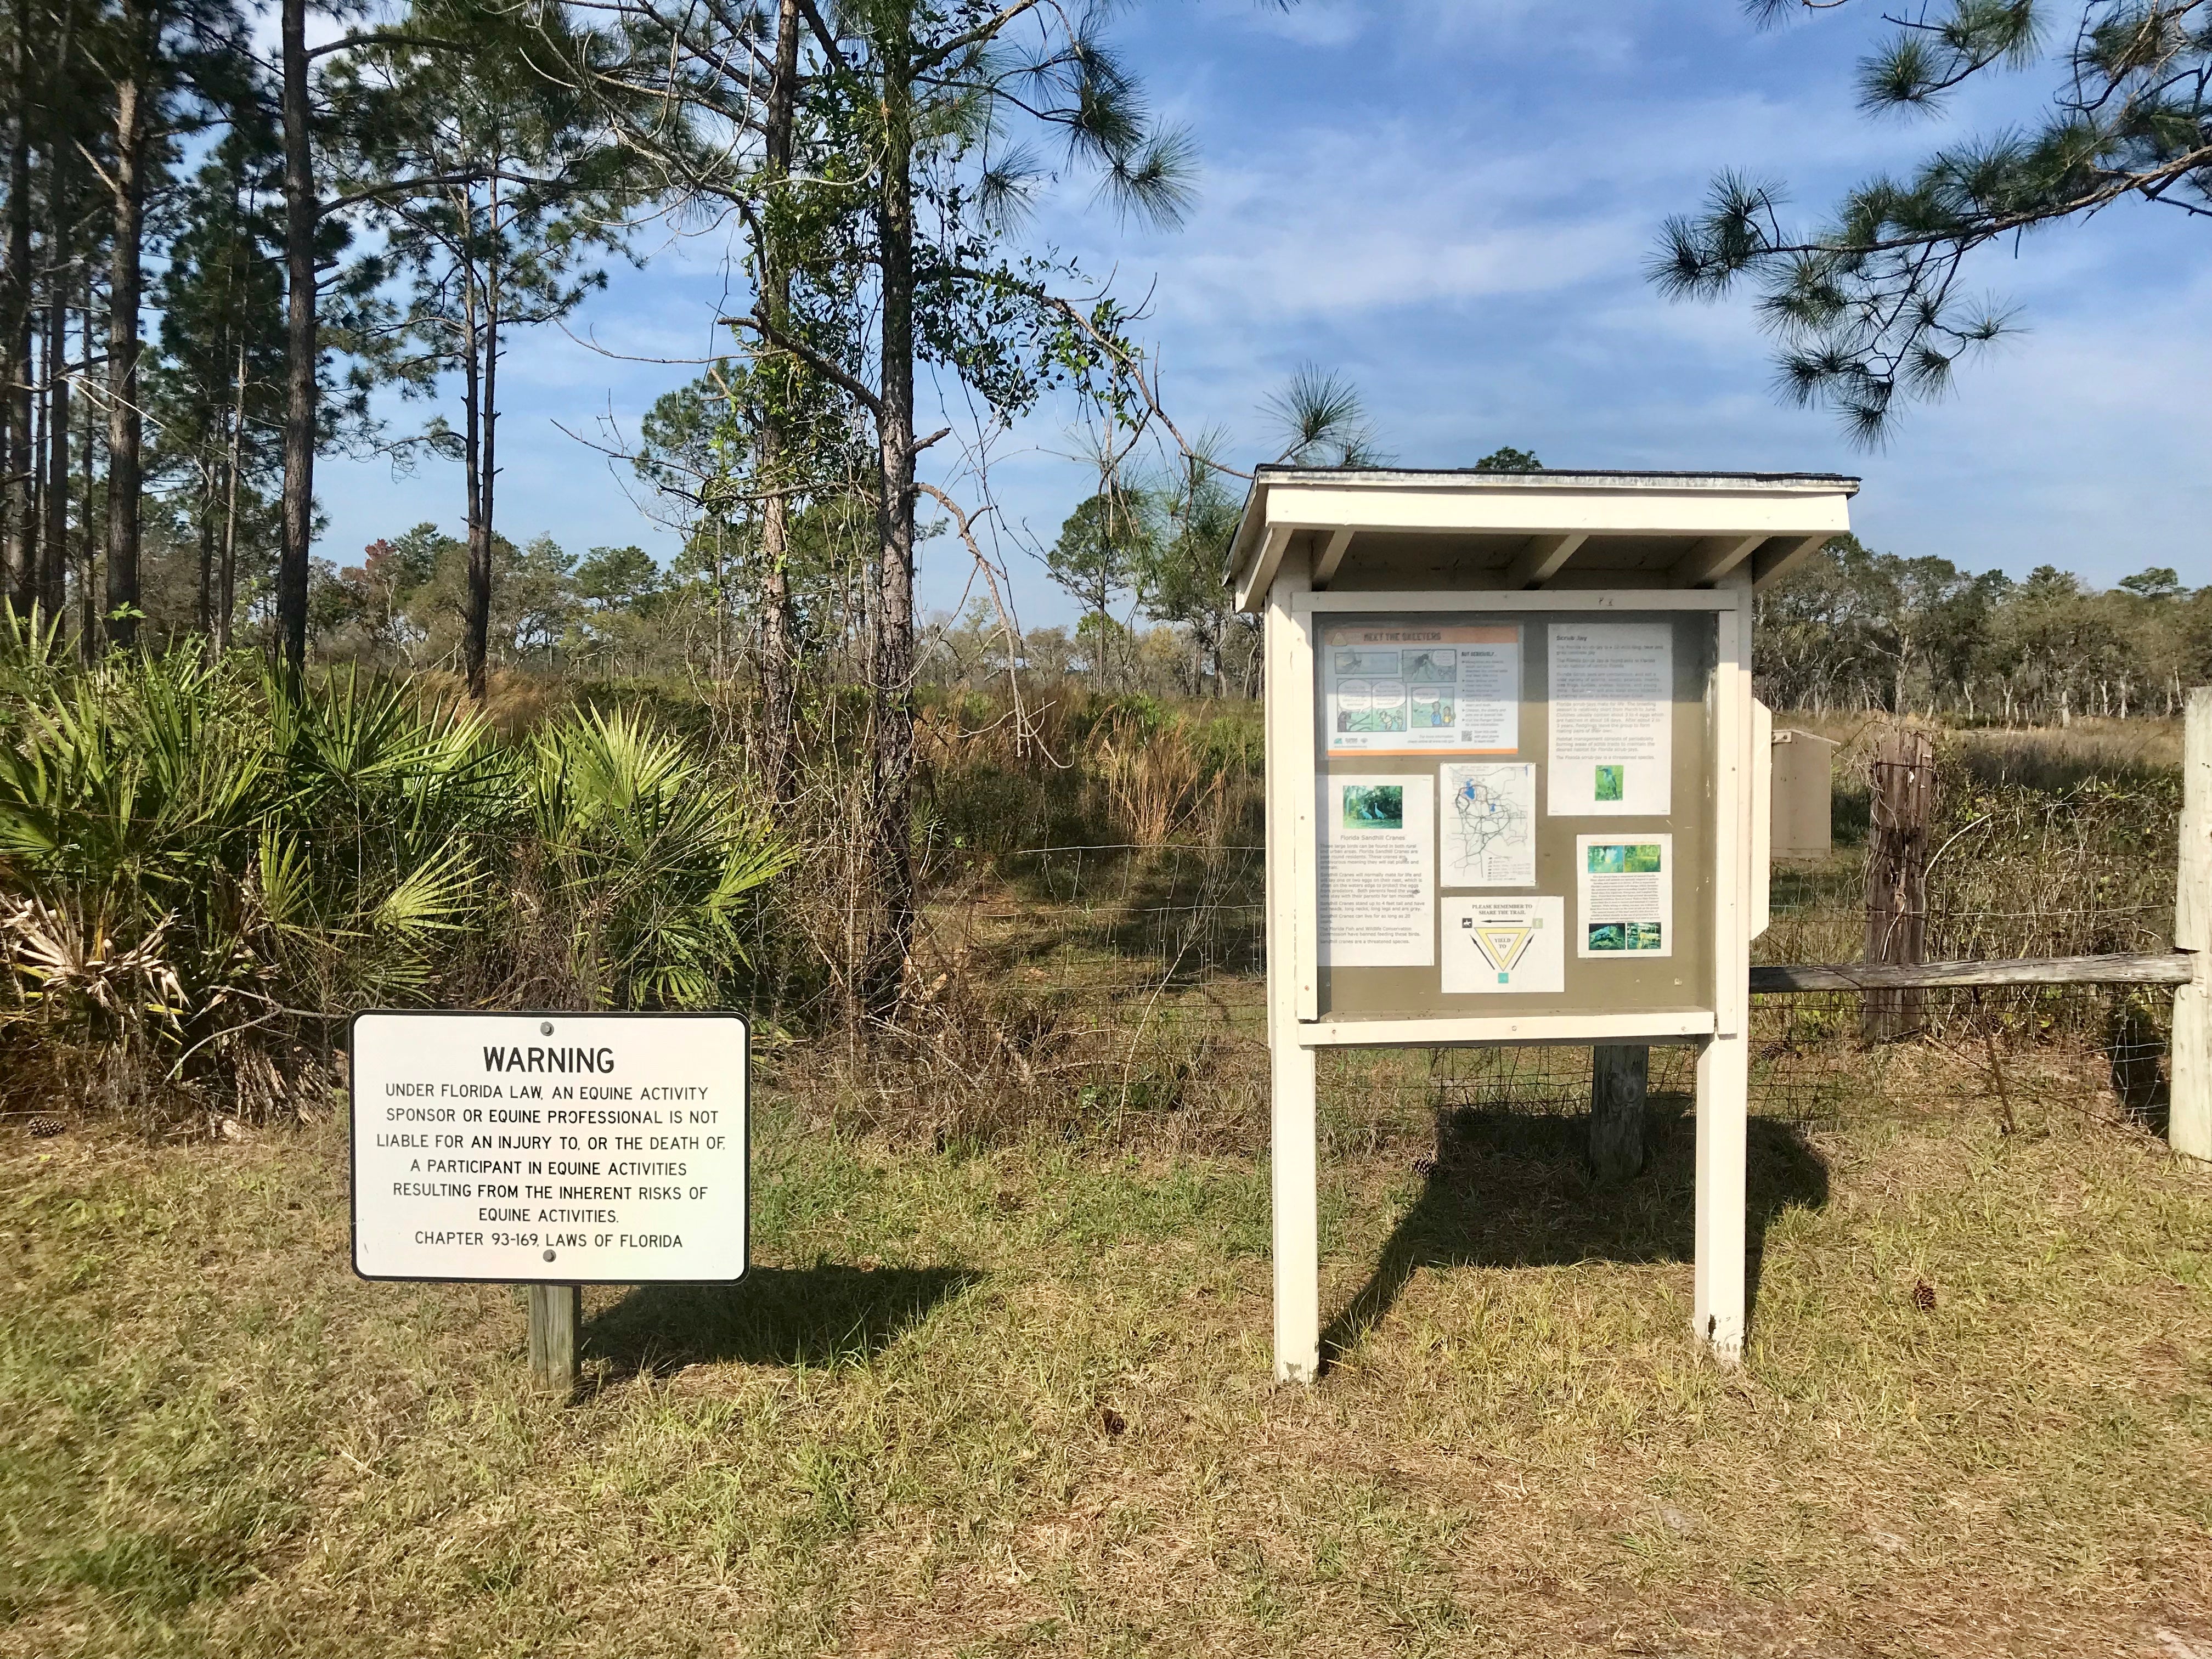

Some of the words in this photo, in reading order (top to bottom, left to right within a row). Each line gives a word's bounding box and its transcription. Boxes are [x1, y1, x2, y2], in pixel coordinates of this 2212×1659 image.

[1364, 632, 1383, 641] MEET
[1386, 632, 1400, 641] THE
[483, 1046, 614, 1074] WARNING
[386, 1083, 434, 1097] UNDER
[441, 1084, 503, 1098] FLORIDA
[551, 1086, 573, 1099] AN
[580, 1086, 633, 1100] EQUINE
[640, 1087, 708, 1101] ACTIVITY
[387, 1108, 455, 1122] SPONSOR
[463, 1109, 482, 1122] OR
[489, 1109, 541, 1124] EQUINE
[548, 1110, 663, 1124] PROFESSIONAL
[670, 1110, 682, 1124] IS
[690, 1110, 719, 1124] NOT
[377, 1134, 429, 1148] LIABLE
[436, 1135, 464, 1148] FOR
[471, 1135, 492, 1149] AN
[499, 1136, 552, 1149] INJURY
[588, 1137, 607, 1150] OR
[614, 1137, 643, 1150] THE
[650, 1137, 698, 1150] DEATH
[410, 1159, 421, 1172] A
[427, 1159, 522, 1174] PARTICIPANT
[529, 1161, 541, 1175] IN
[549, 1161, 601, 1175] EQUINE
[608, 1162, 687, 1176] ACTIVITIES
[393, 1182, 471, 1197] RESULTING
[478, 1184, 518, 1198] FROM
[524, 1186, 552, 1199] THE
[560, 1186, 632, 1200] INHERENT
[639, 1187, 681, 1200] RISKS
[689, 1187, 708, 1200] OF
[479, 1207, 531, 1222] EQUINE
[538, 1209, 619, 1223] ACTIVITIES.
[415, 1231, 483, 1245] CHAPTER
[545, 1233, 587, 1247] LAWS
[594, 1234, 613, 1247] OF
[620, 1234, 682, 1248] FLORIDA
